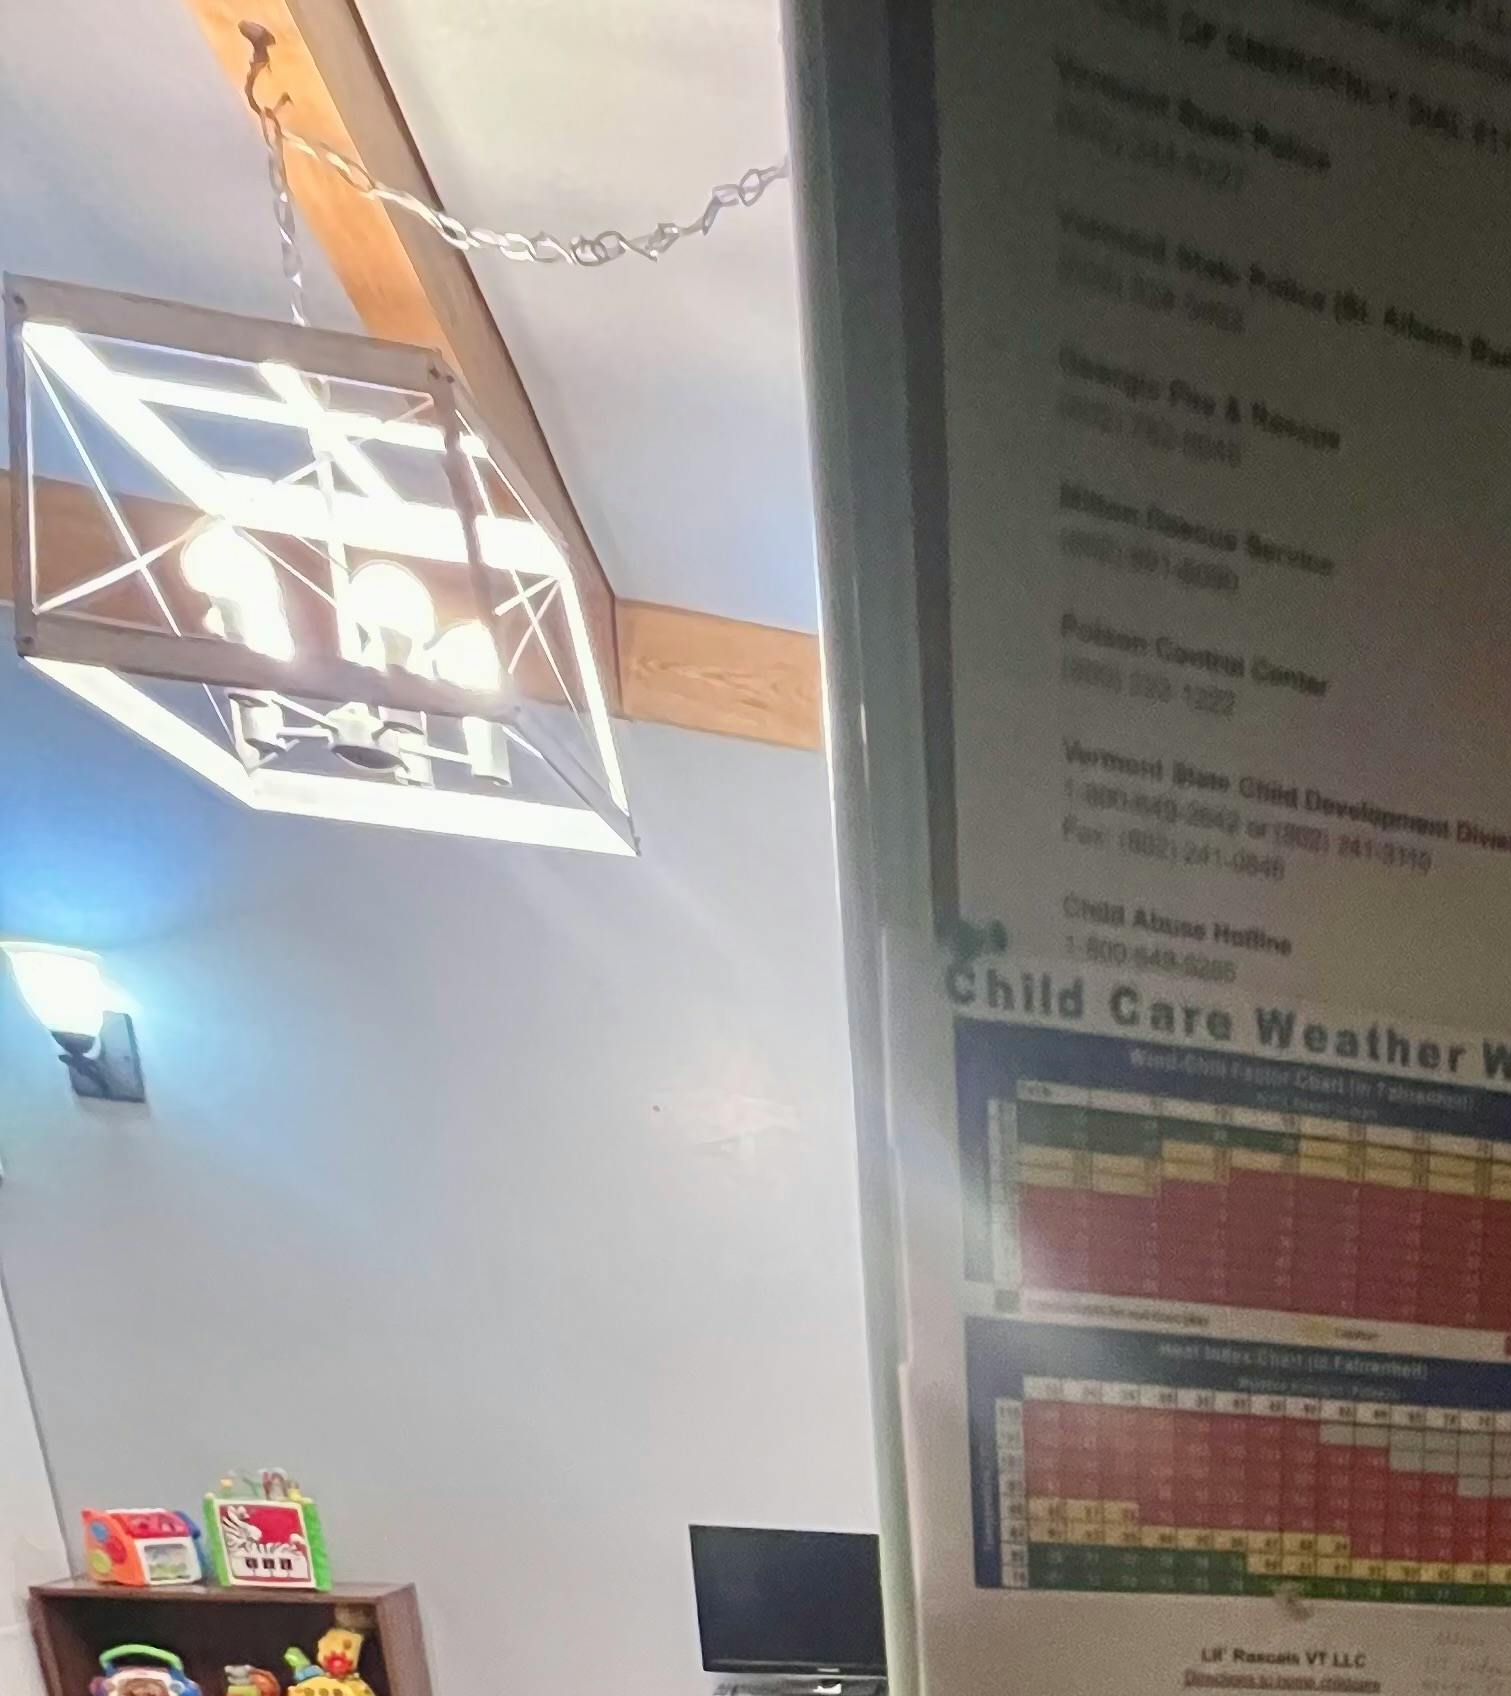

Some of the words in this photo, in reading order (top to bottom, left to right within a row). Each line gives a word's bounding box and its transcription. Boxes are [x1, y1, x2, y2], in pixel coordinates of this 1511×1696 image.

[1155, 633, 1245, 678] Control
[1062, 736, 1163, 781] Vermont
[1239, 776, 1299, 809] Child
[1304, 787, 1451, 839] Development
[1063, 893, 1125, 926] Child
[1133, 906, 1206, 941] Abuse
[1213, 921, 1293, 958] Hotline
[944, 961, 1086, 1021] Child
[1108, 983, 1234, 1043] Care
[1255, 1005, 1467, 1076] Weather
[1233, 1648, 1300, 1665] Rascals
[1305, 1652, 1327, 1666] VT
[1332, 1652, 1367, 1668] LLC
